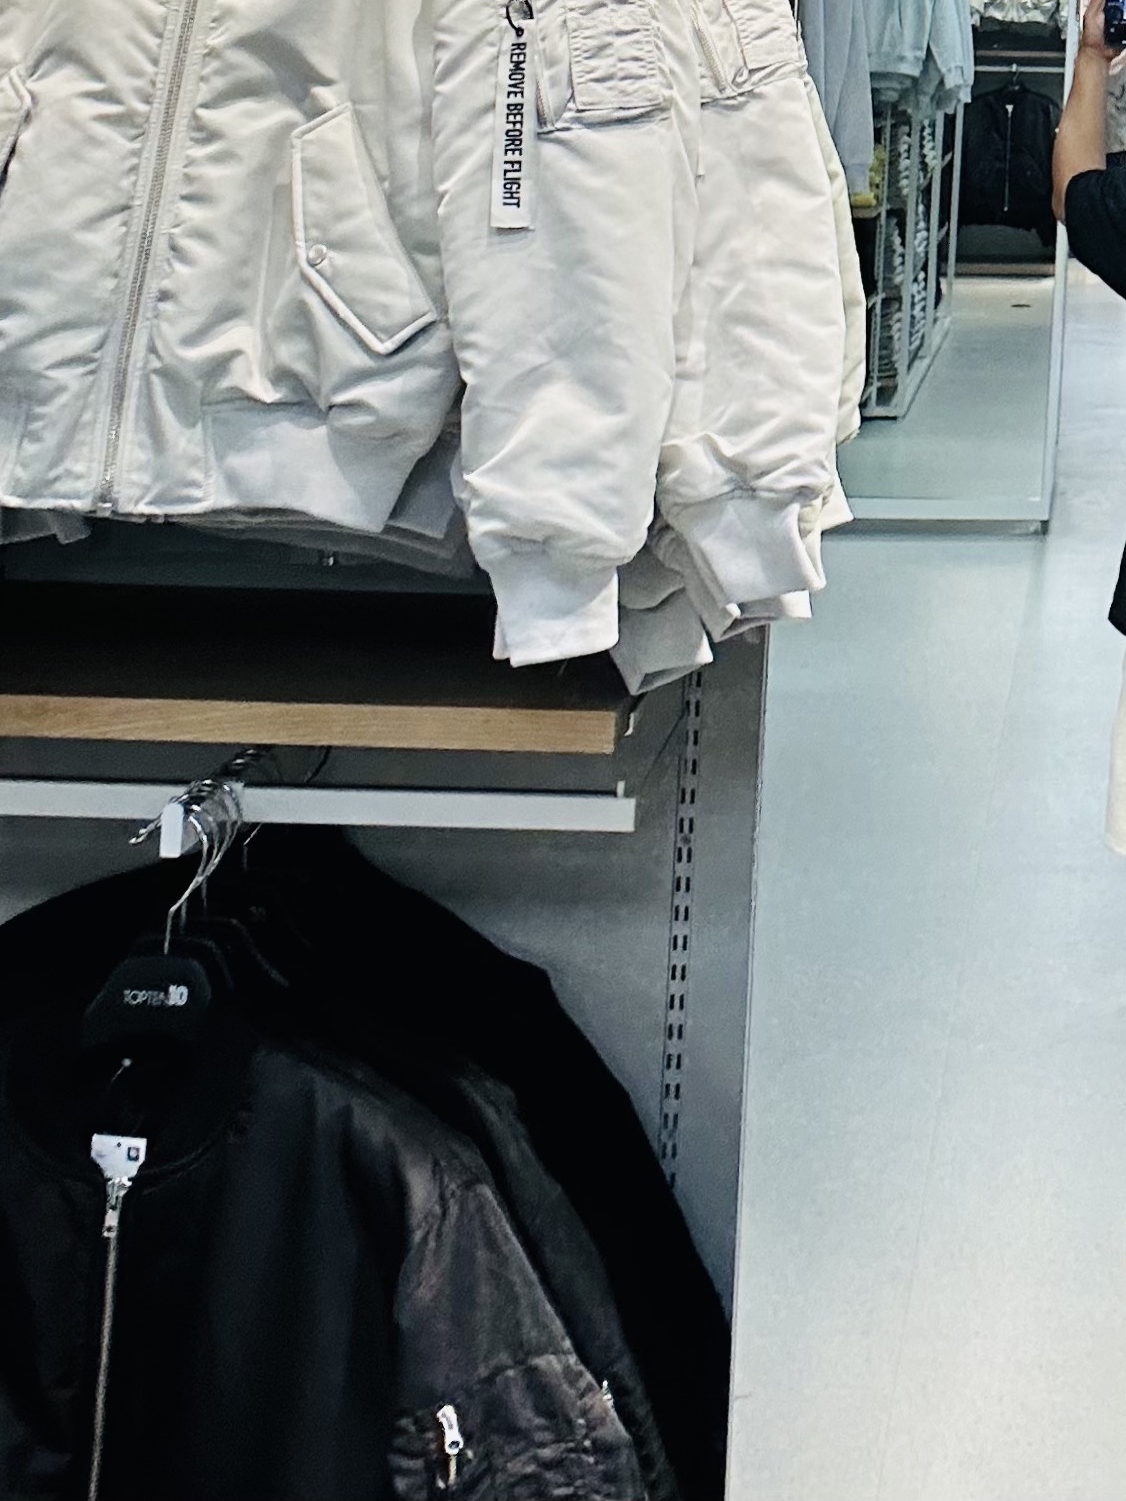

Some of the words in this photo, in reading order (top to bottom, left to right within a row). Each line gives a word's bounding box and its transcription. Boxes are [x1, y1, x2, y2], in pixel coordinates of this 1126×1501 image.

[507, 42, 527, 99] REMOVE
[504, 103, 524, 156] BEFORE
[502, 160, 523, 208] FLIGHT
